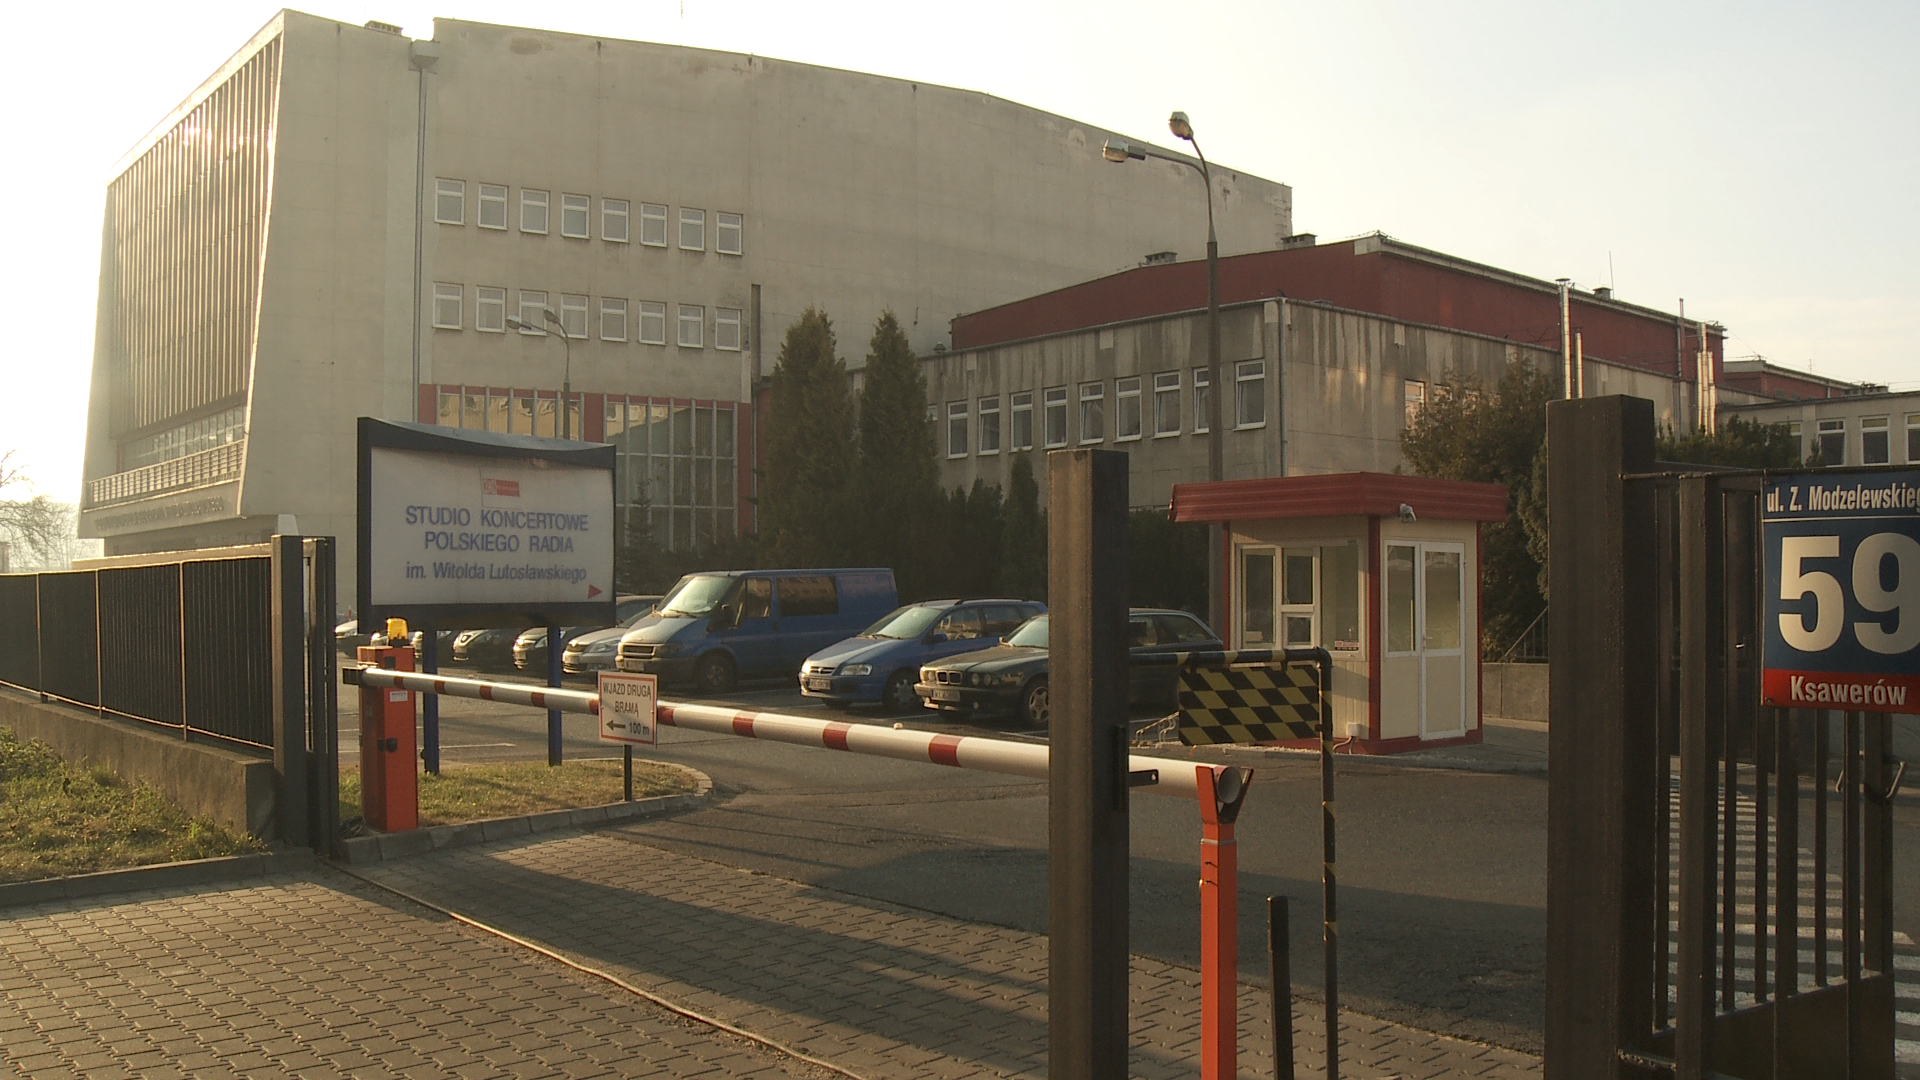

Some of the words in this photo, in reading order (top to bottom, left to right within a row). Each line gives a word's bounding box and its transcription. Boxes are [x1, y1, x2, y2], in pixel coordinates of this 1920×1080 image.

[1767, 487, 1784, 513] ul.
[1790, 486, 1802, 512] Z.
[405, 505, 471, 527] STUDIO
[481, 509, 589, 532] KONCERTOWE
[425, 531, 520, 552] POLSKIEGO
[529, 535, 574, 553] RADIA
[406, 561, 427, 579] im.
[433, 562, 485, 581] Witolda
[1778, 532, 1920, 655] 59
[603, 682, 626, 695] WJAZD
[627, 684, 652, 700] DRUGĄ
[1790, 675, 1907, 706] Ksawerów
[615, 701, 639, 717] BRAMĄ
[629, 722, 641, 734] 100
[643, 726, 649, 735] m
